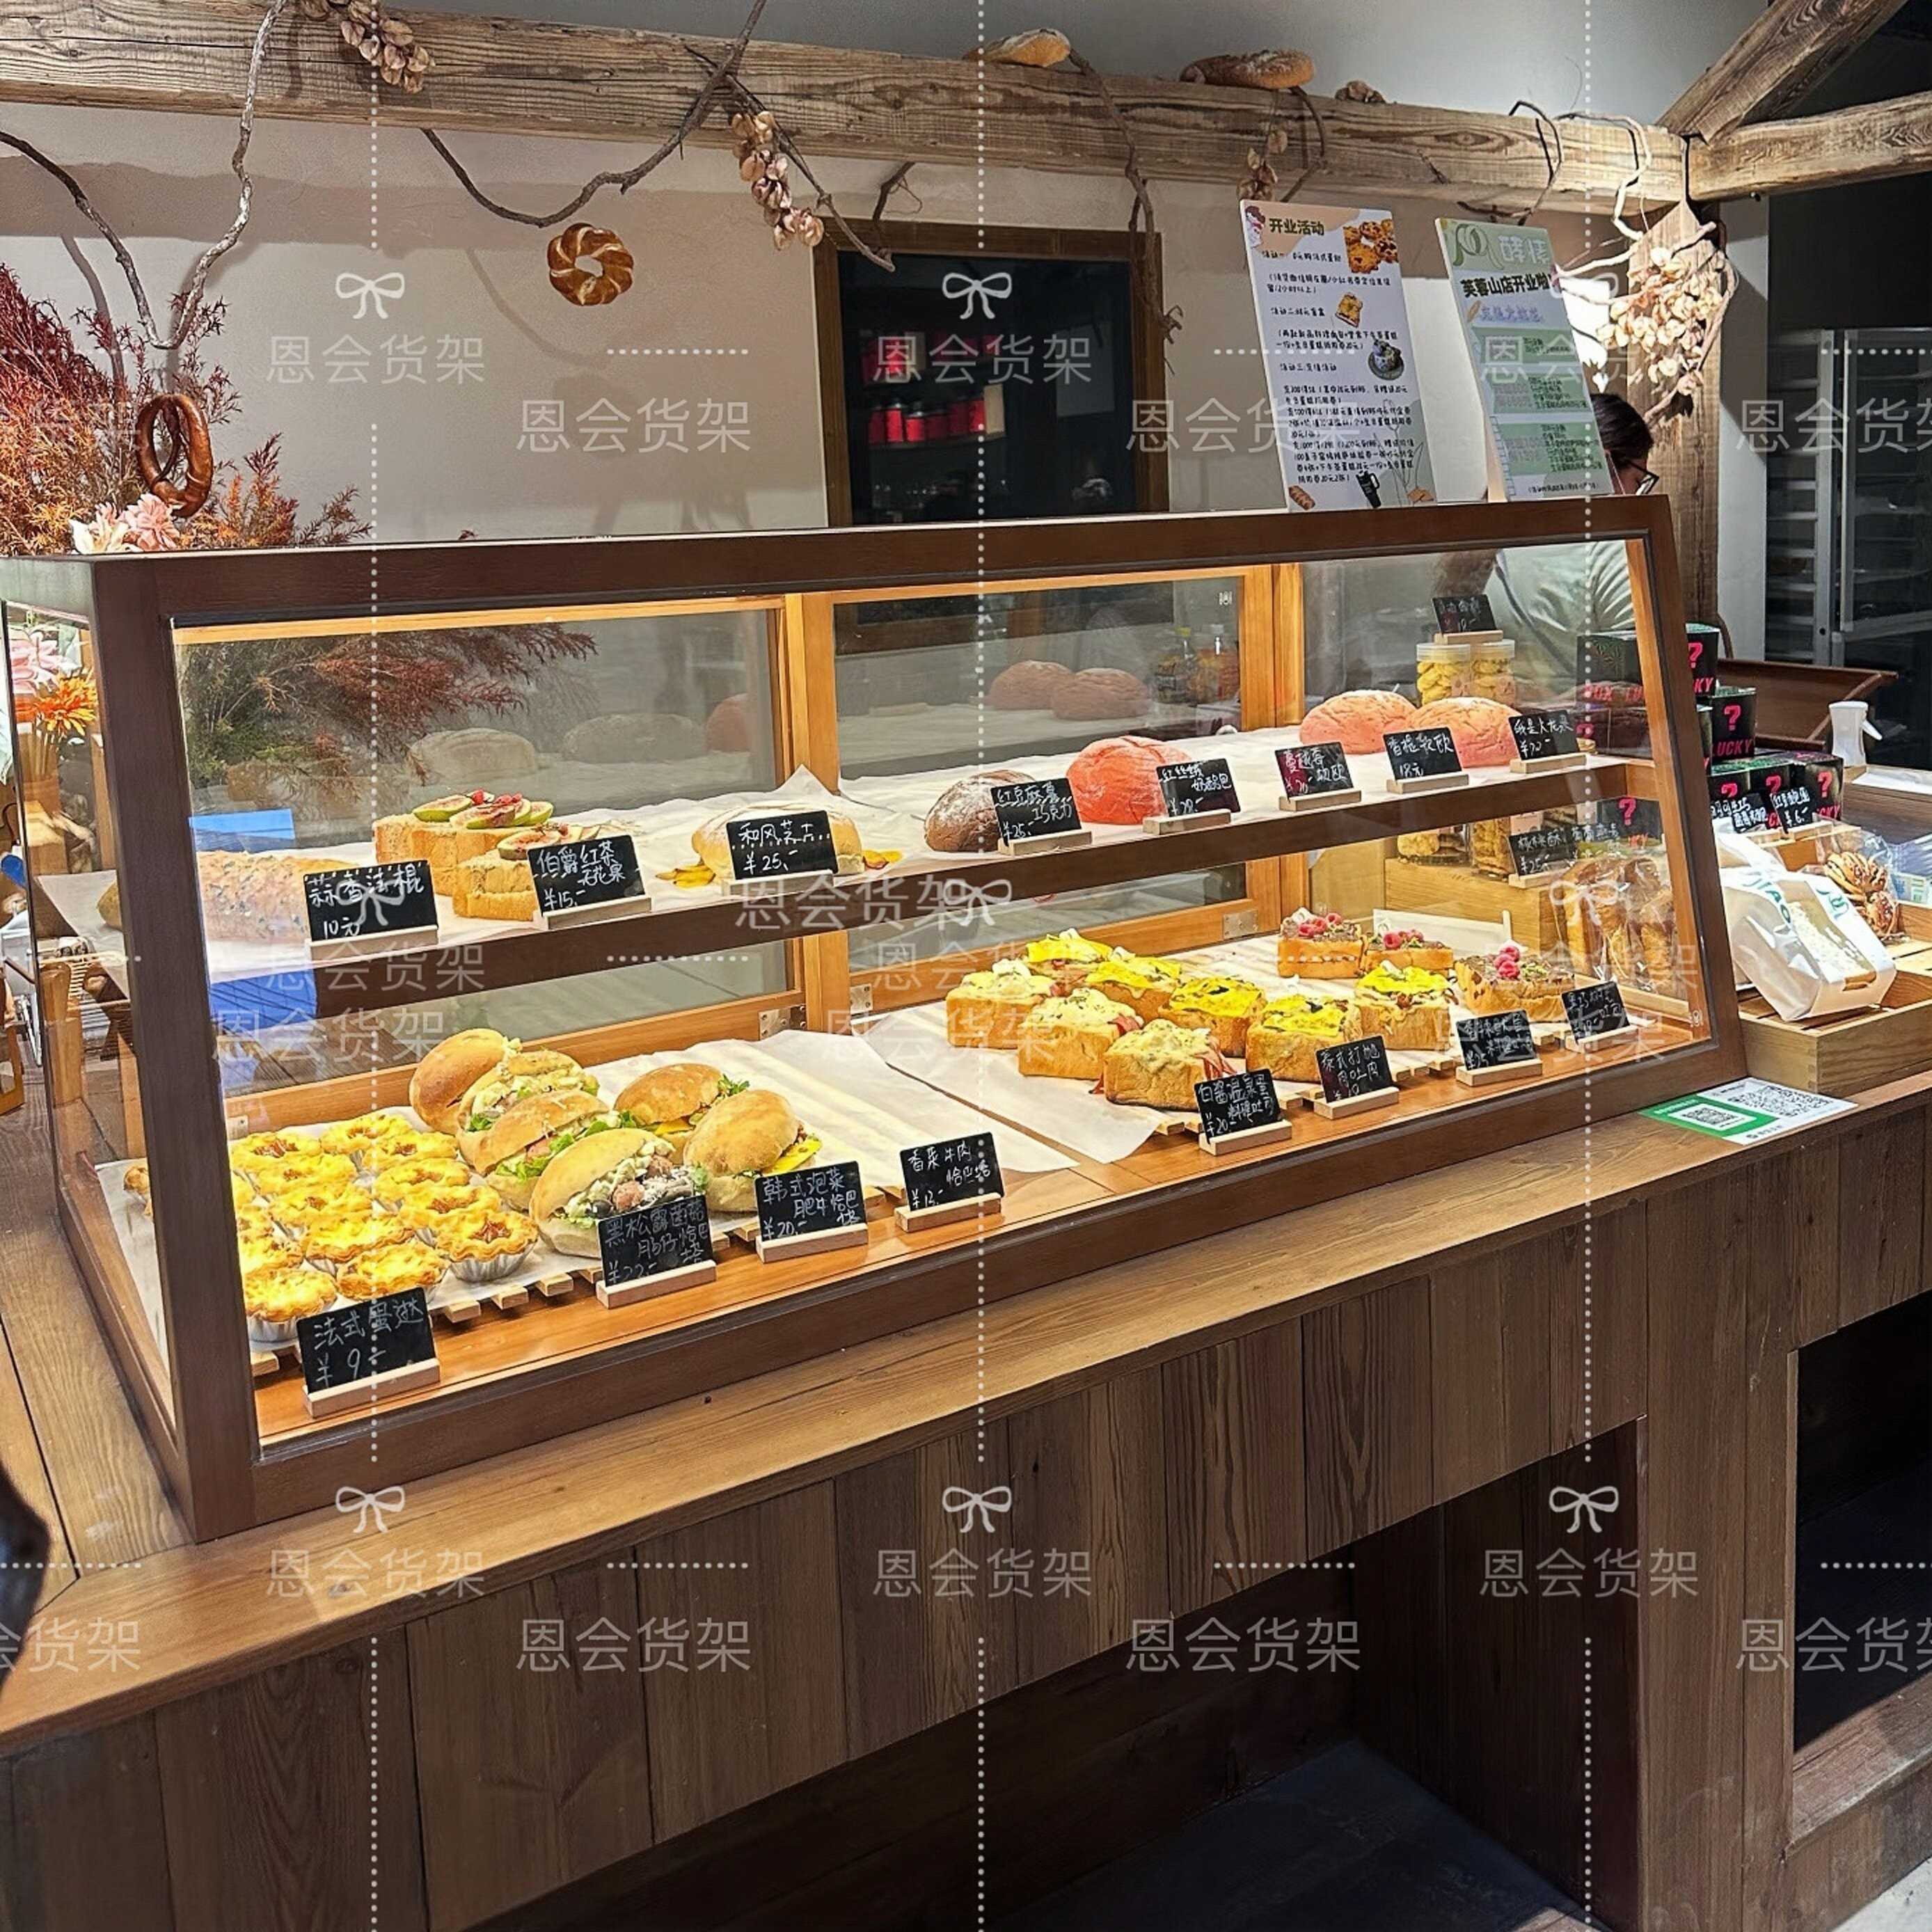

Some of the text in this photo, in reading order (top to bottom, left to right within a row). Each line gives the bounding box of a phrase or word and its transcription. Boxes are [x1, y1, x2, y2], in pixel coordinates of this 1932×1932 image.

[1269, 218, 1325, 236] 开业活动
[1459, 272, 1551, 299] 芙蓉山店开业啦
[1031, 803, 1073, 823] 巧克力
[536, 840, 615, 875] 伯爵红茶
[308, 865, 425, 908] 蒜香法棍
[323, 916, 361, 940] 10元
[908, 1139, 972, 1173] 香菜牛肉
[762, 1169, 846, 1205] 韩式泡菜
[946, 1159, 991, 1187] 恰巴塔
[793, 1189, 859, 1219] 肥牛恰巴
[604, 1203, 706, 1248] 黑松露菌菇
